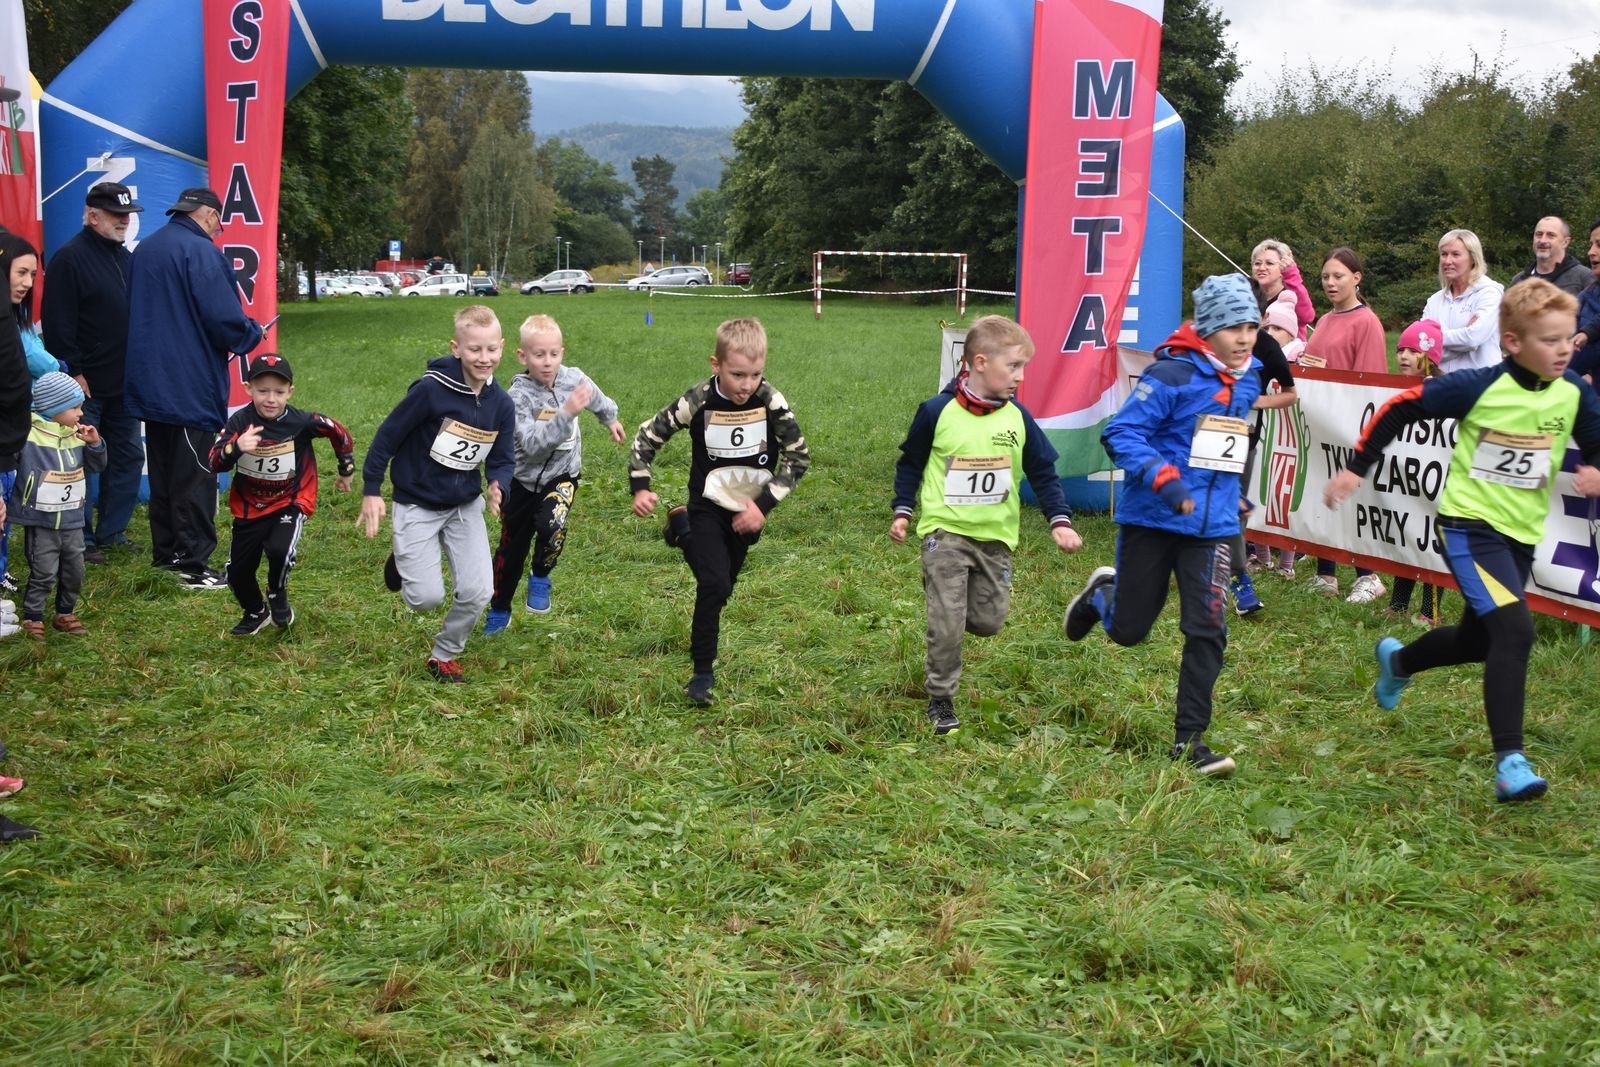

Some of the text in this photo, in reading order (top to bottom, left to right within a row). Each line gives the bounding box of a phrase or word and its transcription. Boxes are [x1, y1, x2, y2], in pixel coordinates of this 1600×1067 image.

[391, 241, 399, 251] P
[730, 427, 745, 447] 6
[1221, 435, 1236, 459] 2
[449, 440, 481, 461] 23
[255, 457, 280, 473] 13
[1495, 449, 1535, 475] 25
[60, 484, 73, 502] 3
[967, 471, 996, 494] 10
[1356, 503, 1409, 547] PRZY
